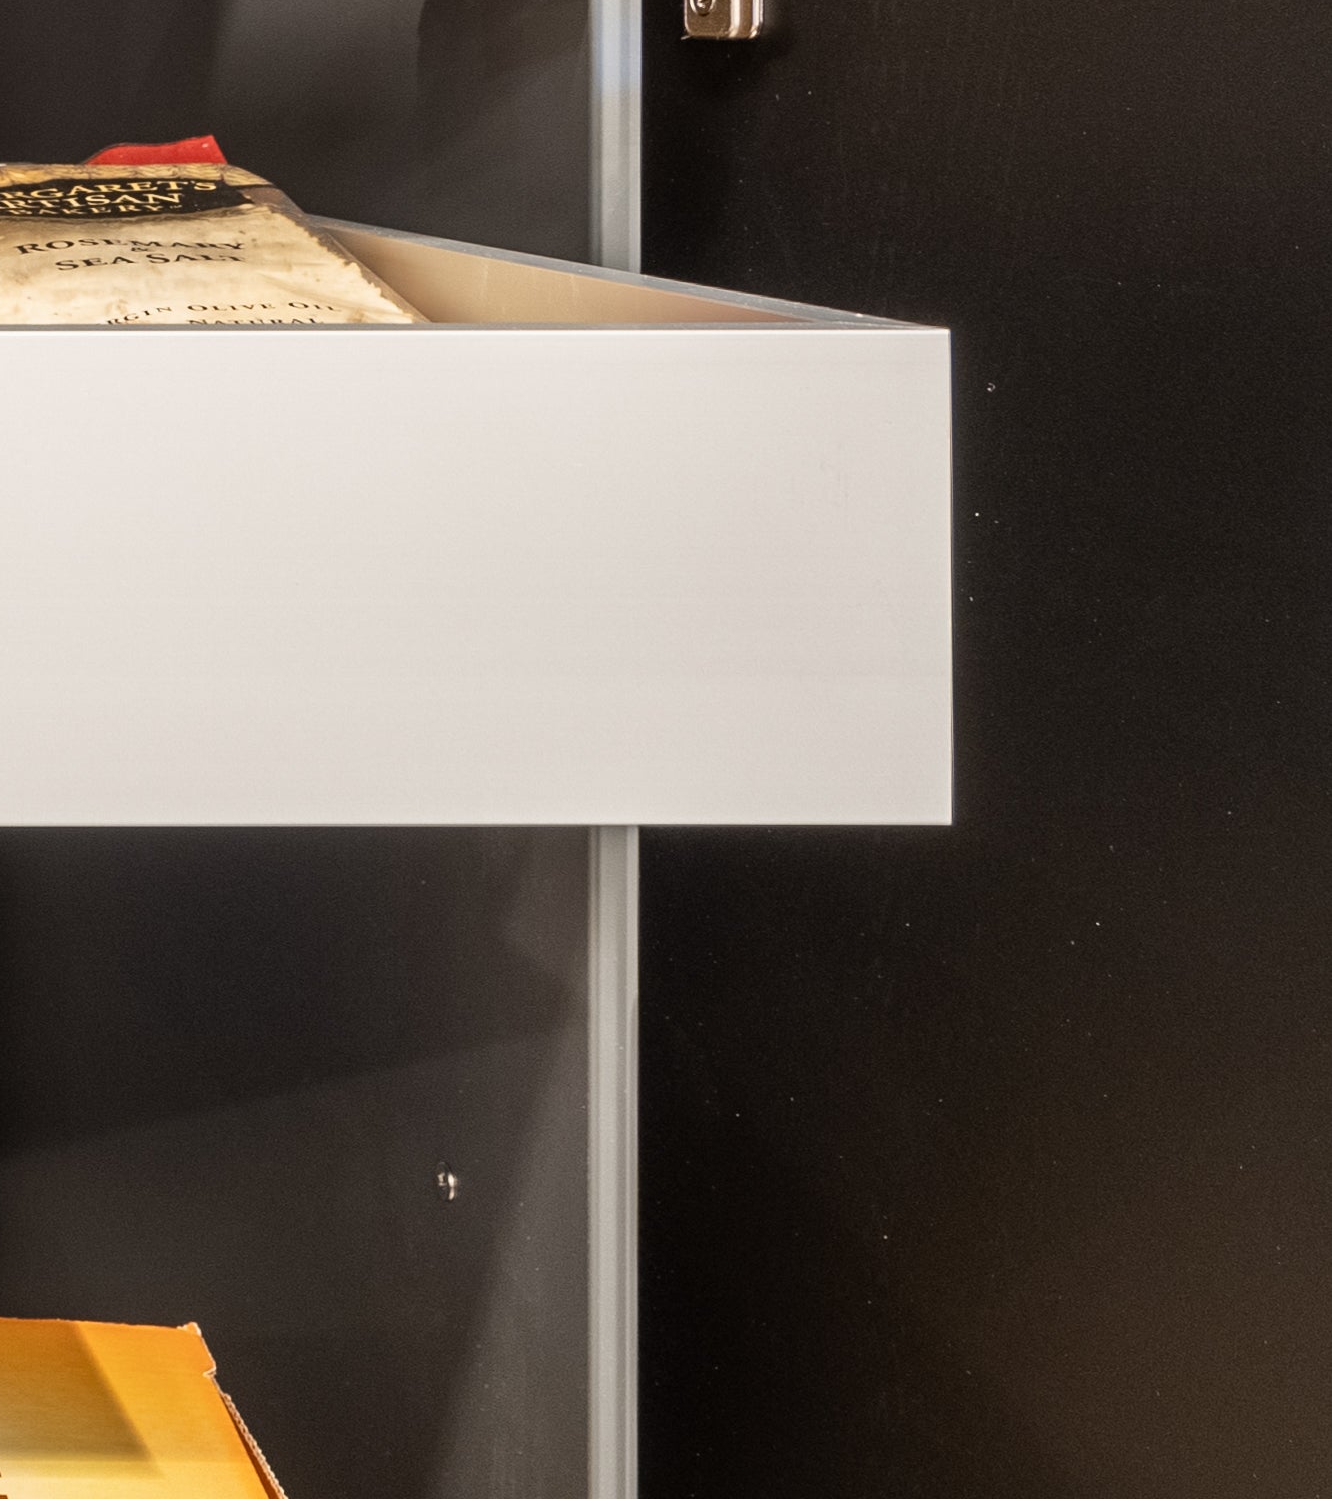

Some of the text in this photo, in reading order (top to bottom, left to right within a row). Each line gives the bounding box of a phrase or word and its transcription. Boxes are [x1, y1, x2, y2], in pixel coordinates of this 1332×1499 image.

[15, 238, 244, 254] ROSEMARY
[55, 253, 245, 272] SEA SALT
